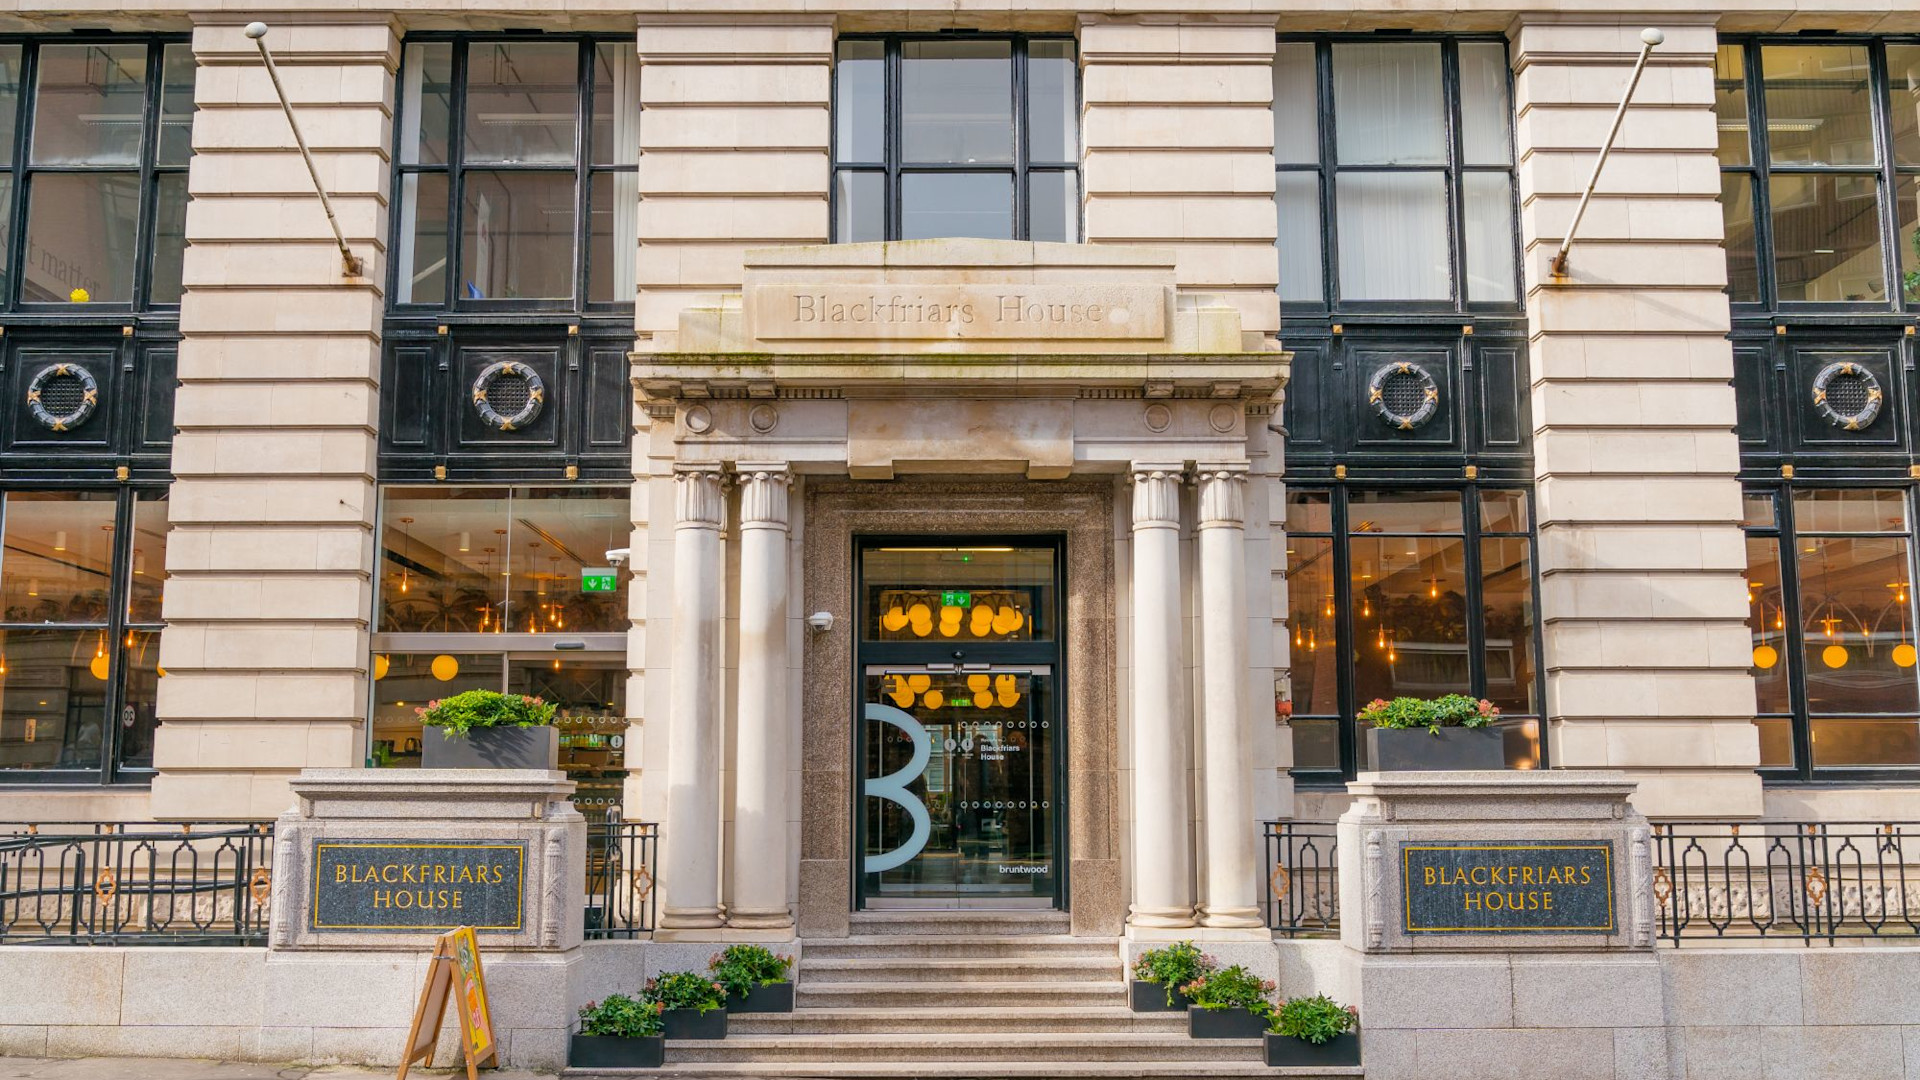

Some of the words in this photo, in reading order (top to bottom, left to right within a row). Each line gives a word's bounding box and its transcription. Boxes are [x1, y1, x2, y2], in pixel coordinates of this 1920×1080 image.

[792, 295, 975, 324] Blackfriars
[995, 295, 1103, 324] House
[980, 744, 1020, 752] Blackfriars
[335, 864, 503, 884] BLACKFRIARS
[999, 865, 1048, 874] bruntwood
[1424, 866, 1591, 885] BLACKFRIARS
[373, 890, 463, 909] HOUSE
[1464, 892, 1553, 911] HOUSE
